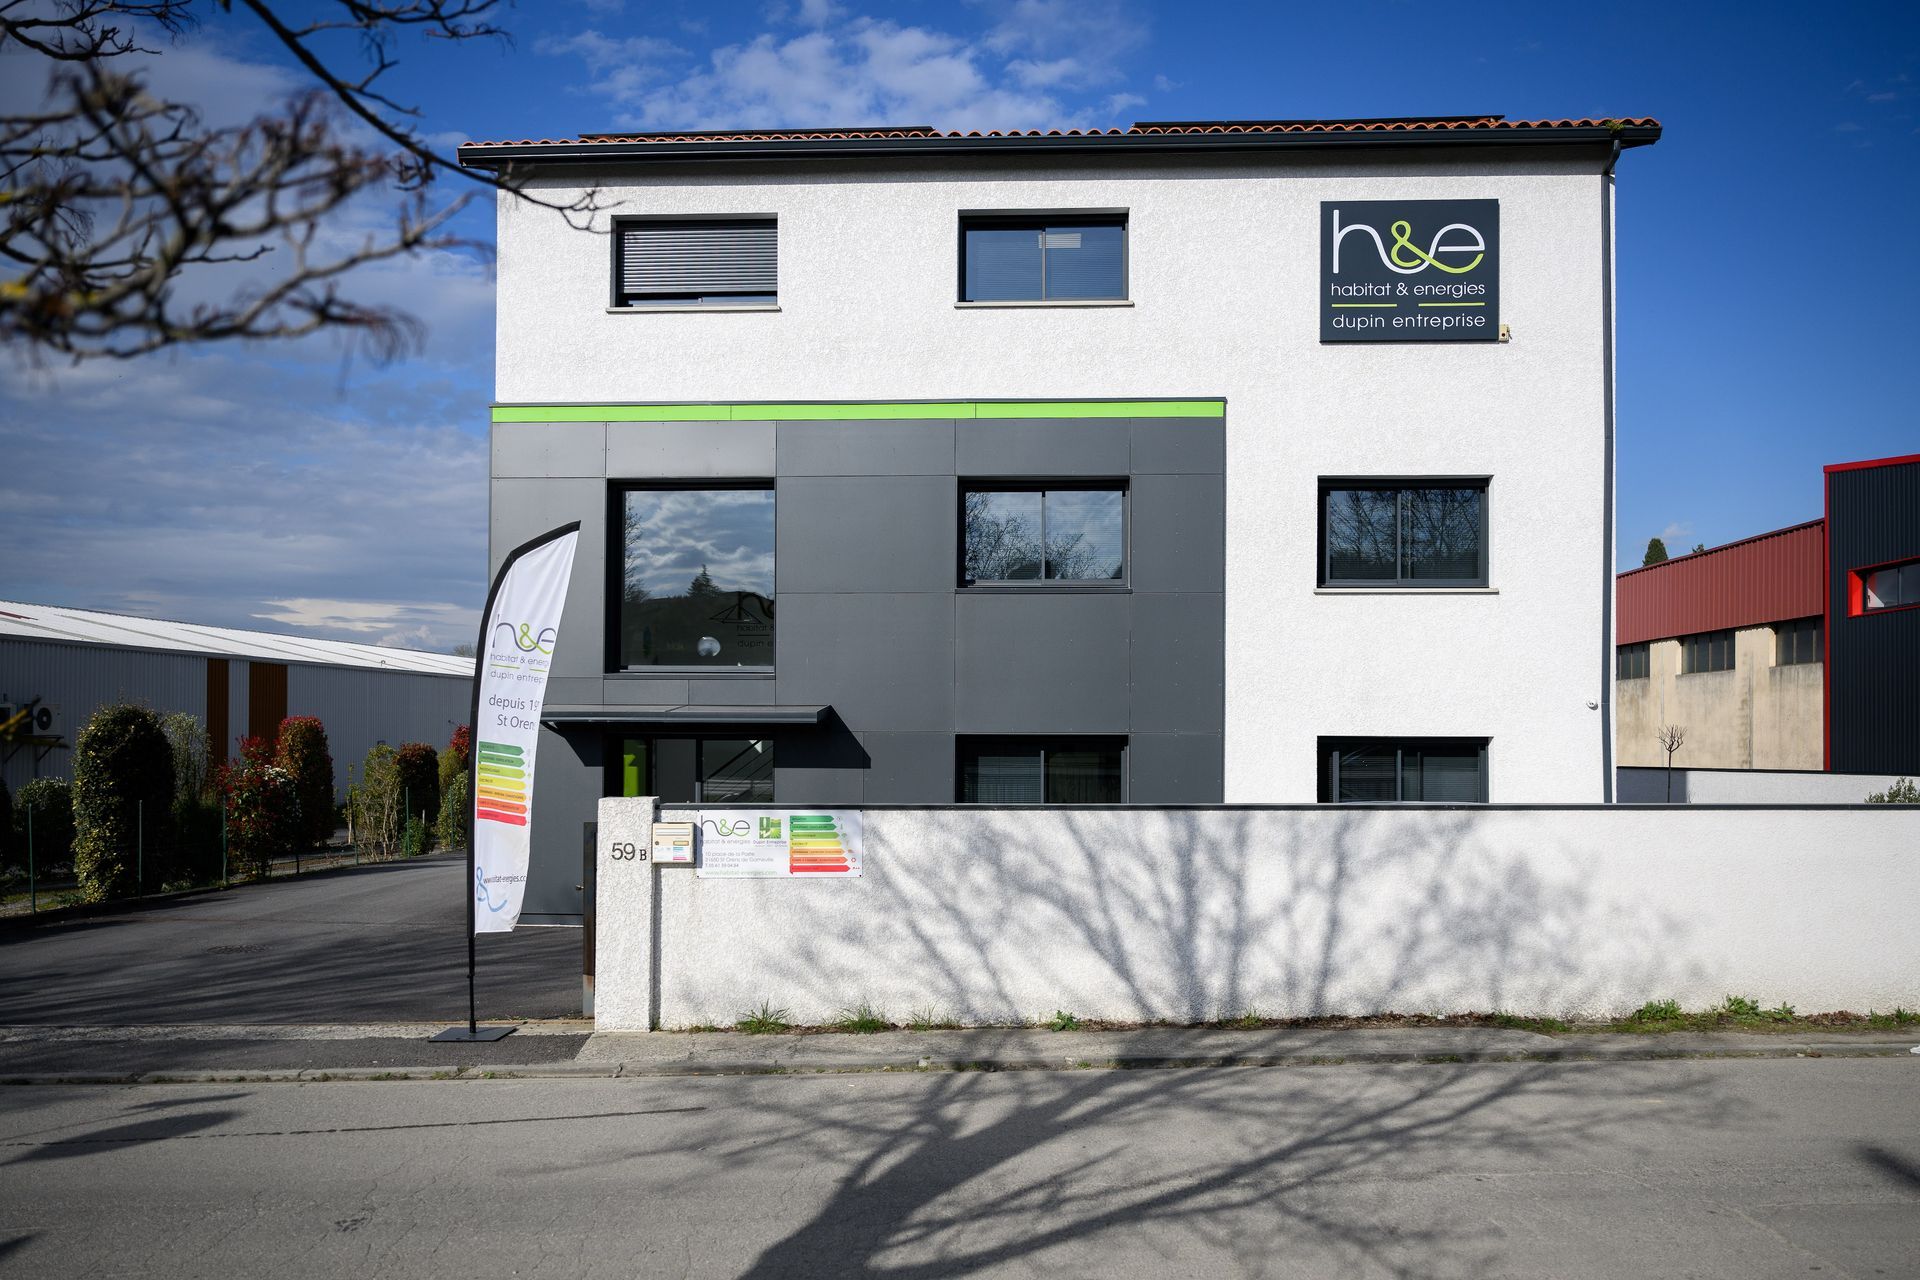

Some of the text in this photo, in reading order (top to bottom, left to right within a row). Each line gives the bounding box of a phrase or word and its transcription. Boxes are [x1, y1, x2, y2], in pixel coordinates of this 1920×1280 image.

[1332, 209, 1486, 275] h&e
[1331, 281, 1485, 299] habitat & energies
[1332, 313, 1486, 331] dupin entreprise
[490, 653, 519, 664] habitat
[490, 669, 514, 681] dupin
[488, 694, 525, 710] depuis
[497, 714, 508, 727] St
[611, 842, 636, 861] 59
[639, 849, 647, 861] B
